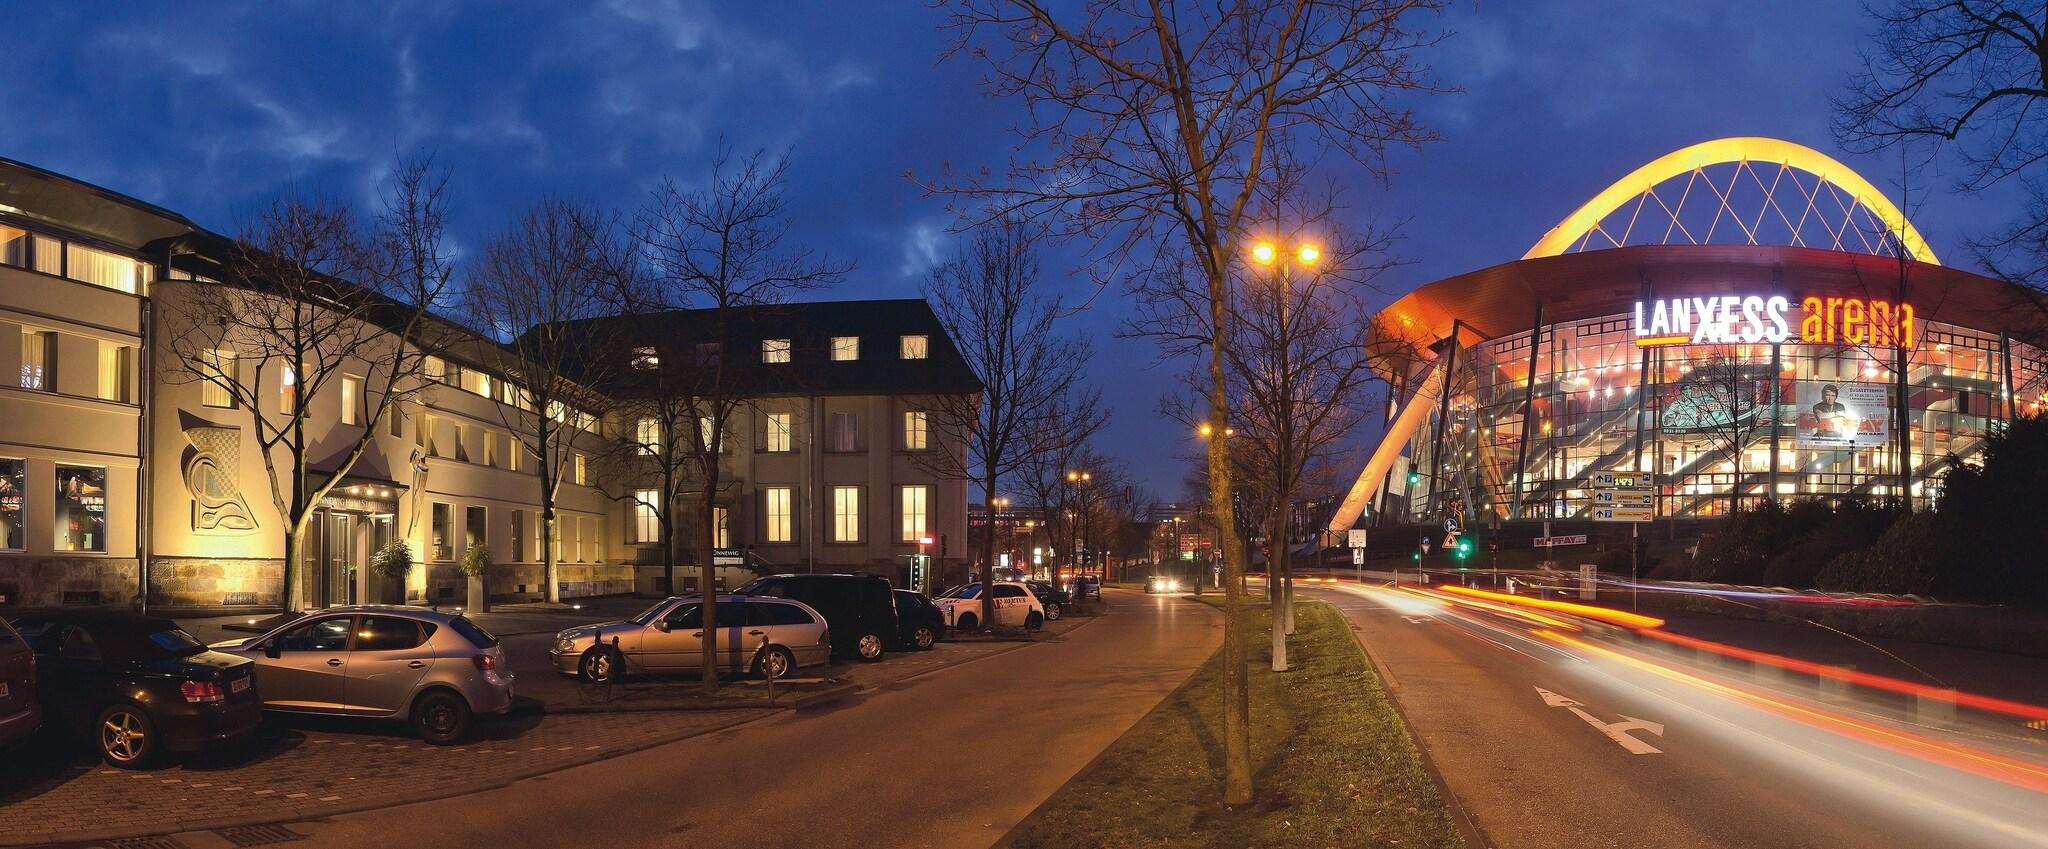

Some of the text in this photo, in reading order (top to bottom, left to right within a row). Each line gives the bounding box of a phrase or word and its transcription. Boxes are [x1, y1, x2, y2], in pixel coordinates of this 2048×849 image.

[1635, 296, 1914, 348] LANXESS arena
[1799, 416, 1885, 432] MAAY
[1615, 478, 1633, 486] 1479
